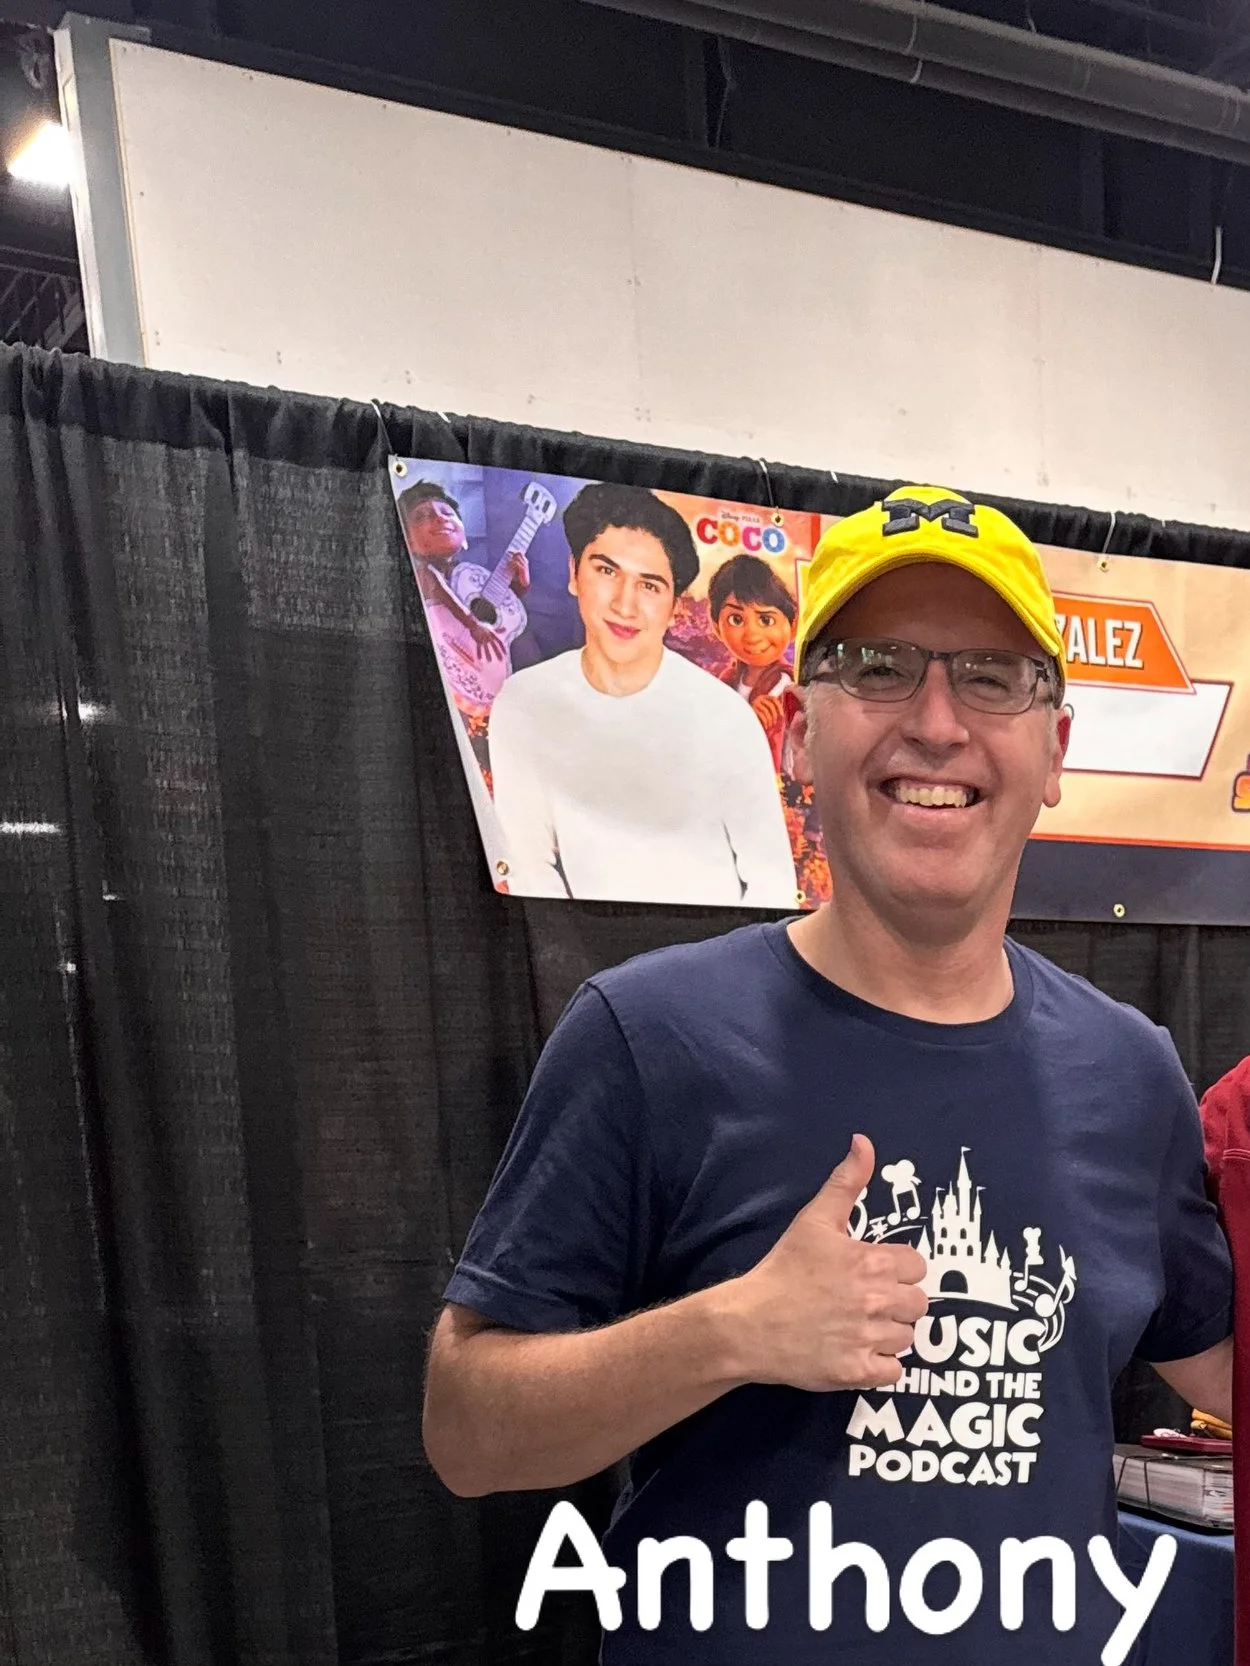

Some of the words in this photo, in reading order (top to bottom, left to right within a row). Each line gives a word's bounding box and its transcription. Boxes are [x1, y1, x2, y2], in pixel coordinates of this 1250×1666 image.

[696, 517, 785, 553] COCO
[881, 498, 979, 538] M
[896, 1314, 1047, 1368] USIC
[864, 1366, 980, 1397] HIND
[985, 1371, 1043, 1399] THE
[846, 1394, 1044, 1450] MAGIC
[848, 1444, 1037, 1486] PODCAST
